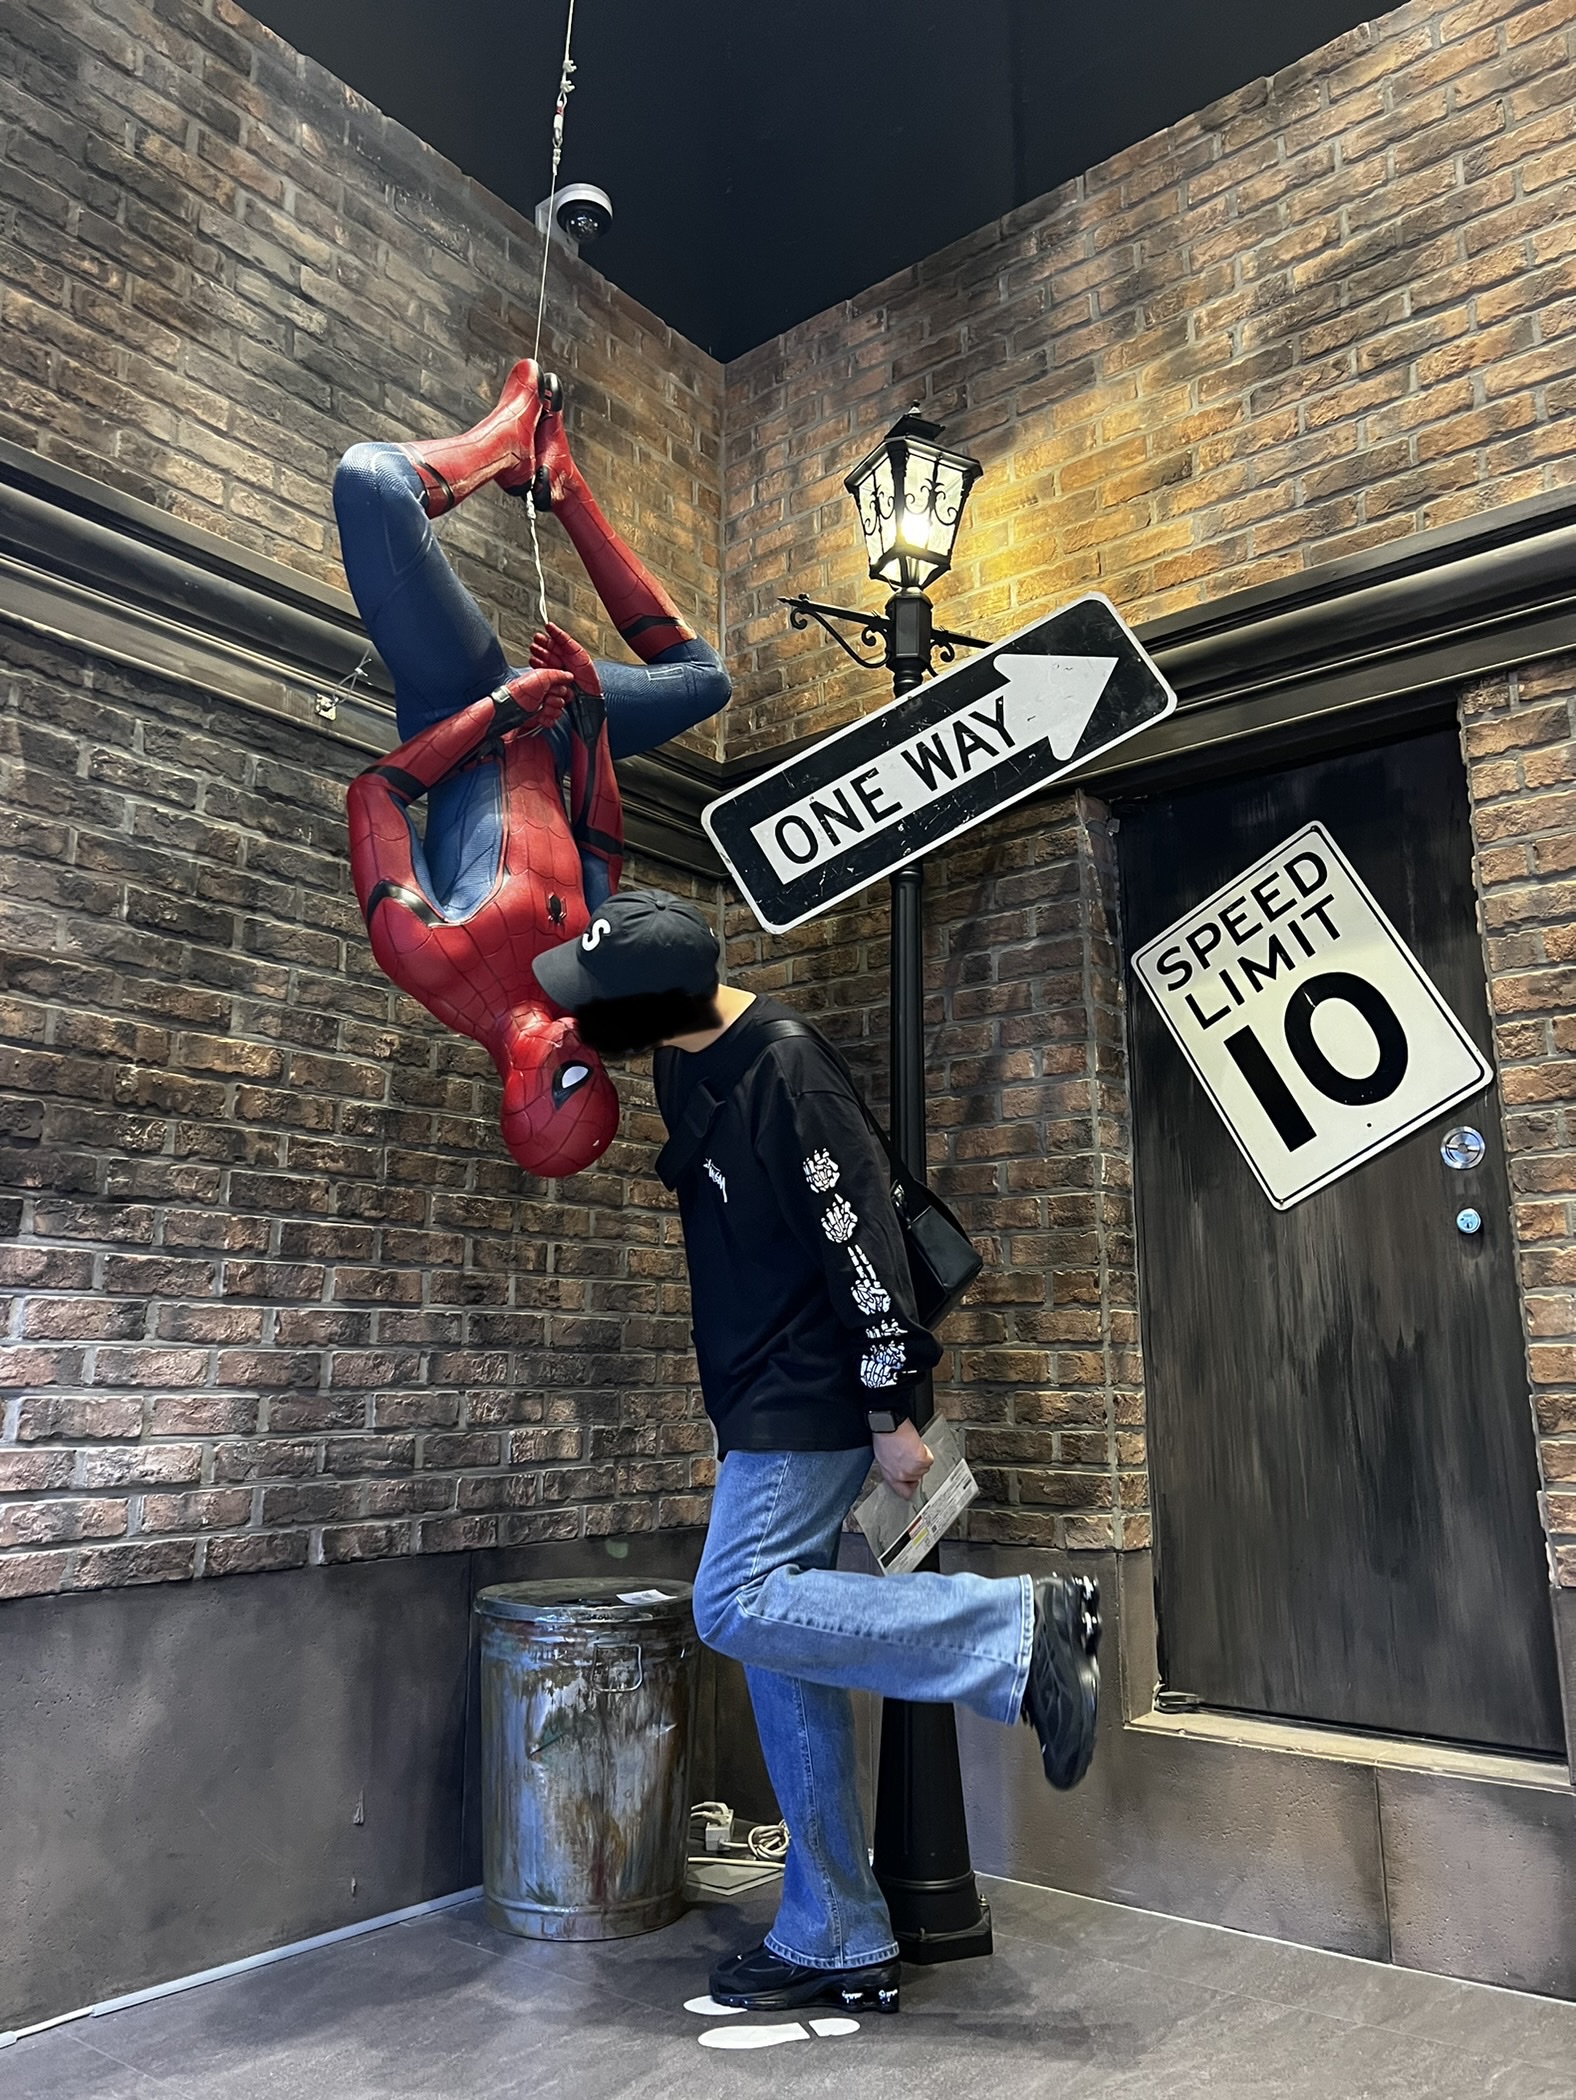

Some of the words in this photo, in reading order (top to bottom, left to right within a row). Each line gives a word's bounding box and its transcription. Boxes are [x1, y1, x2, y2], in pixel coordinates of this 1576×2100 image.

[774, 767, 904, 865] ONE
[900, 695, 1016, 792] WAY
[581, 918, 611, 951] S
[1156, 851, 1328, 992] SPEED
[1184, 893, 1341, 1031] LIMIT
[1223, 971, 1409, 1153] 10
